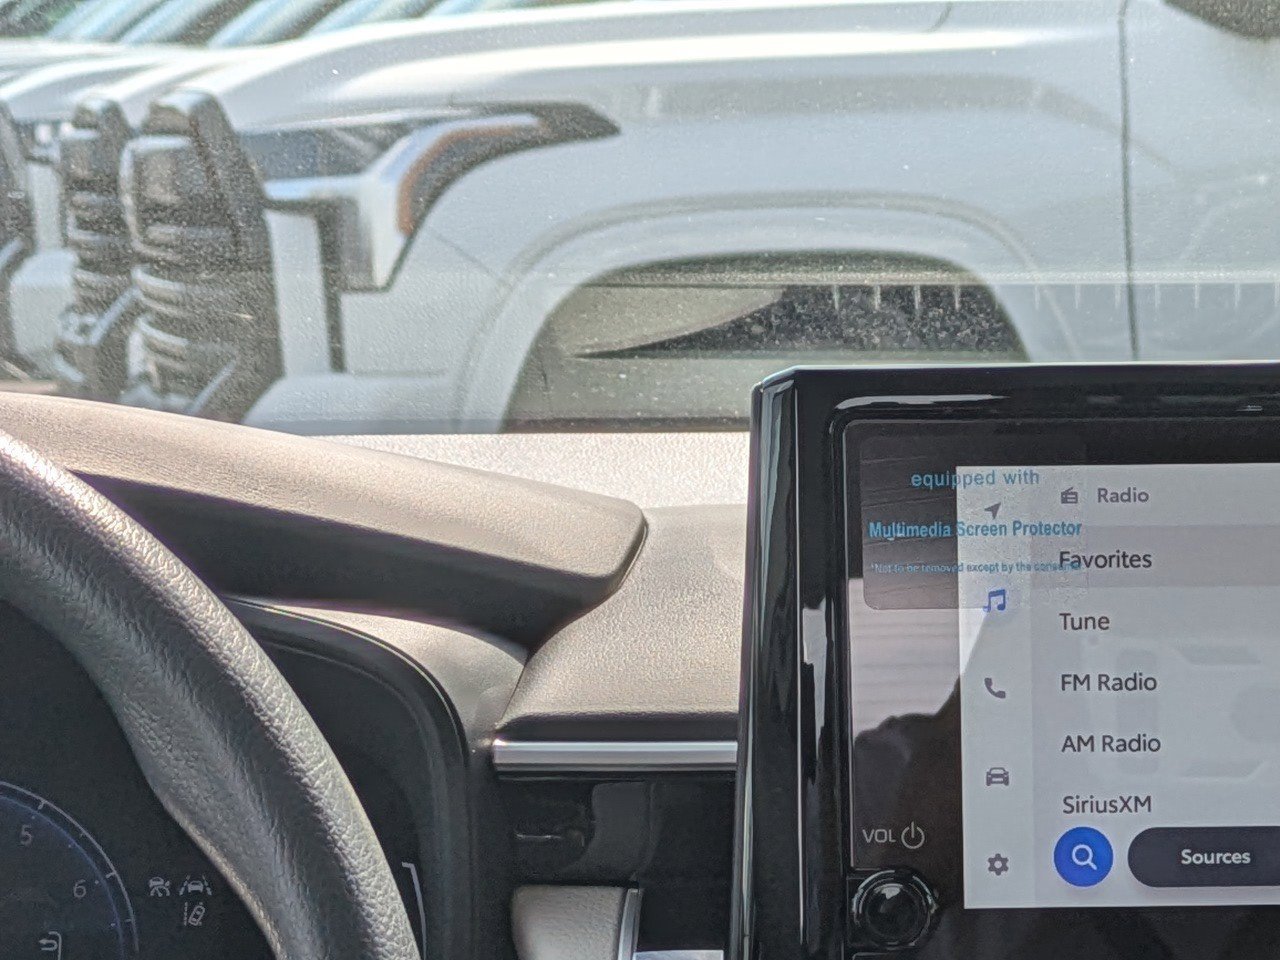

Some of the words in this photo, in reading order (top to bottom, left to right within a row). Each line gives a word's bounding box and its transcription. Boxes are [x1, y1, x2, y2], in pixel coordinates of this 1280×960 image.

[911, 470, 996, 491] equipped
[1002, 469, 1040, 485] with
[1097, 487, 1149, 503] Radio
[868, 521, 951, 539] Multimedia
[956, 520, 1007, 537] Screen
[1013, 520, 1082, 537] Protector
[967, 562, 999, 574] except
[1002, 562, 1013, 574] by
[1016, 561, 1031, 572] the
[1059, 550, 1152, 570] Favorites
[1059, 612, 1110, 630] Tune
[1061, 674, 1091, 691] FM
[1098, 672, 1157, 691] Radio
[1061, 736, 1095, 753] AM
[1102, 734, 1161, 753] Radio
[1062, 796, 1152, 814] SiriusXM
[20, 826, 33, 846] 5
[862, 829, 896, 844] VOL
[1181, 849, 1251, 865] Sources
[73, 881, 87, 898] 6
